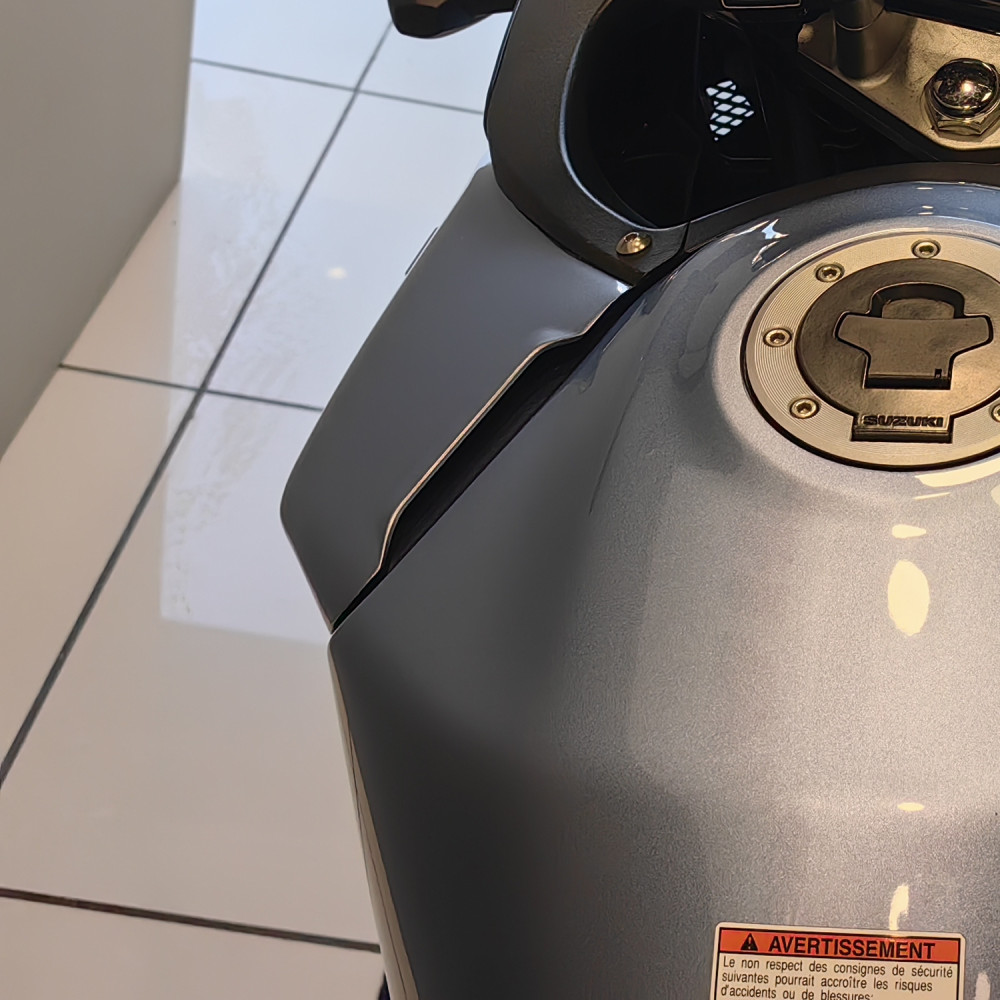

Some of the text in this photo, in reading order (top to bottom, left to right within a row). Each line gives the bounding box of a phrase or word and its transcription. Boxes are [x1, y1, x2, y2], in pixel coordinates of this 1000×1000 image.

[863, 415, 944, 428] SUZUKI
[768, 935, 936, 960] AVERTISSEMENT
[723, 955, 953, 978] Le non respect des consignes de sécurité
[720, 984, 777, 999] d'accidents
[782, 990, 796, 1000] ou
[801, 988, 815, 1000] de
[722, 970, 933, 994] suivantes pourrait accroître les risques
